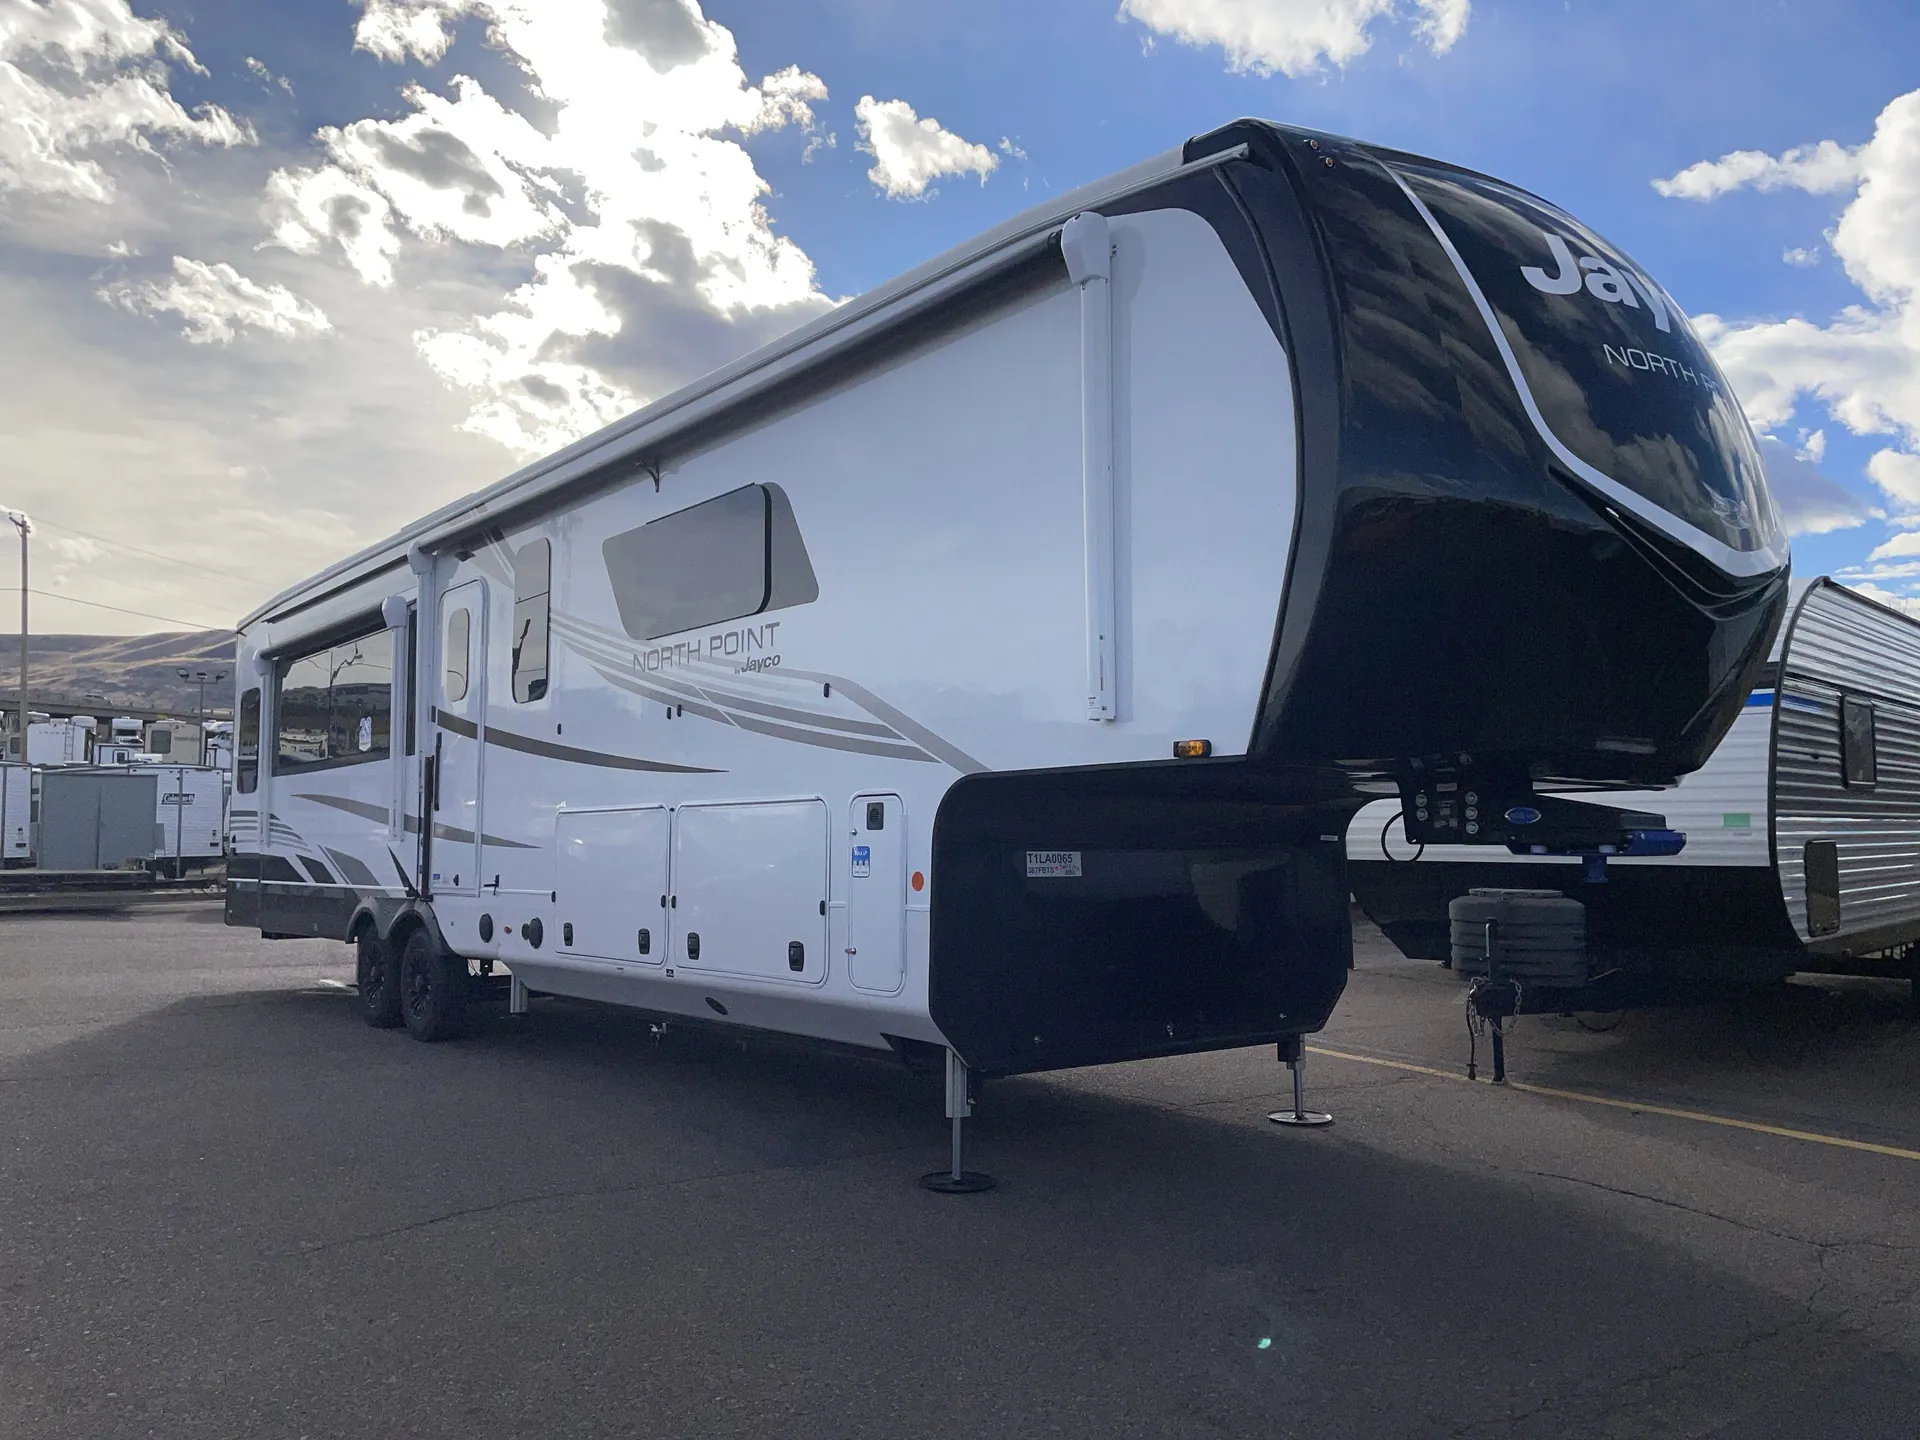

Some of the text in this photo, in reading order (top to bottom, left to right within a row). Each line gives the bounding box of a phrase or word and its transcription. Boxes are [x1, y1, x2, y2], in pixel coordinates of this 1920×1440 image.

[1603, 343, 1698, 386] NORTH
[633, 621, 781, 674] NORTH POINT
[741, 654, 781, 674] Jayco
[1027, 853, 1073, 864] T1LA0065
